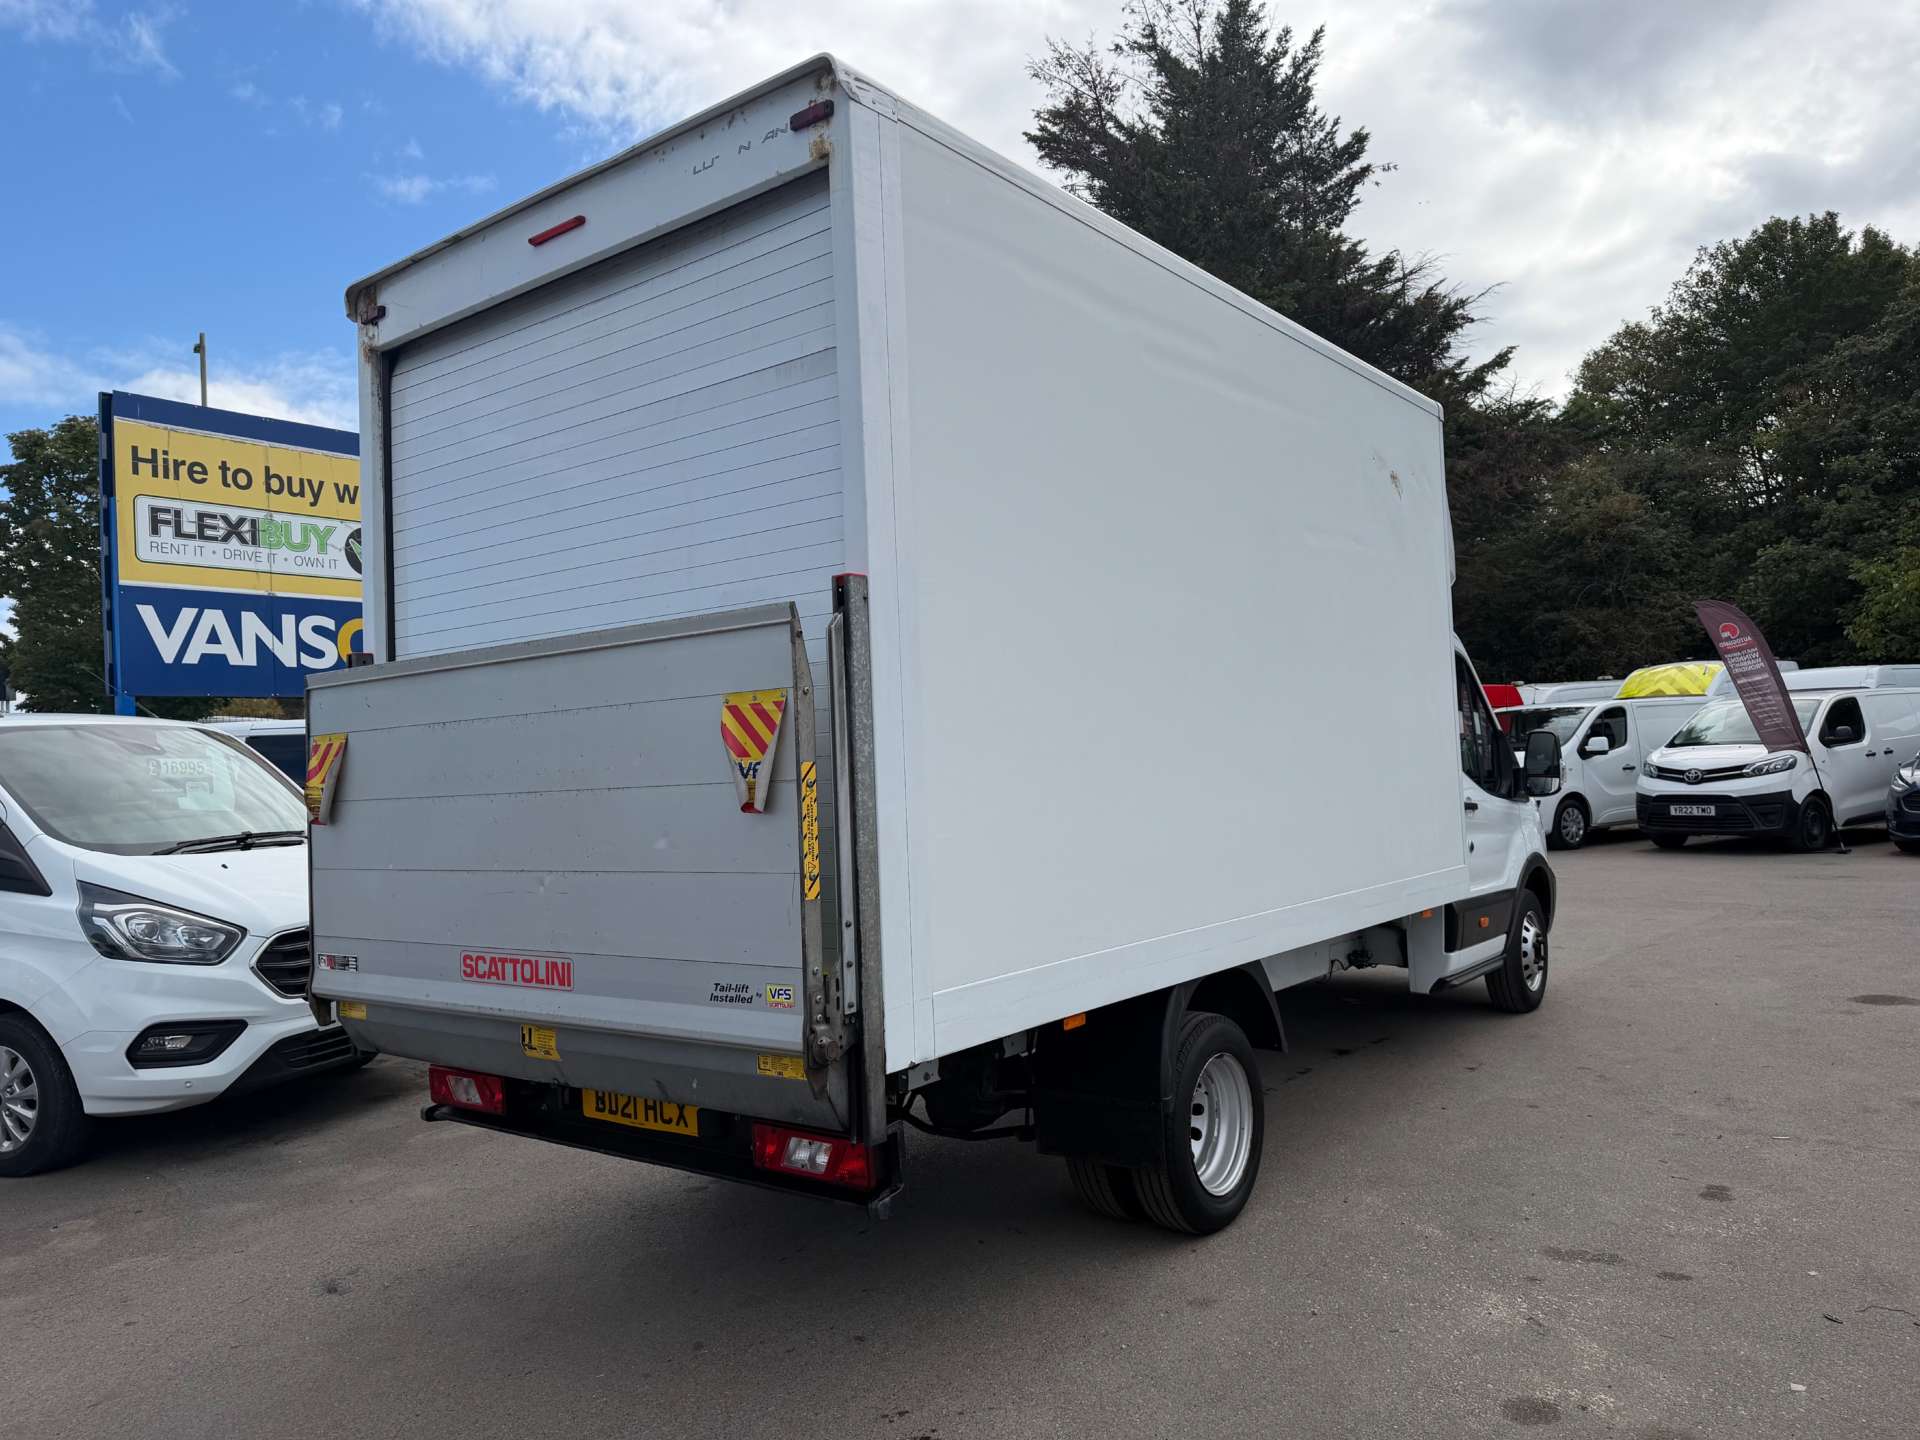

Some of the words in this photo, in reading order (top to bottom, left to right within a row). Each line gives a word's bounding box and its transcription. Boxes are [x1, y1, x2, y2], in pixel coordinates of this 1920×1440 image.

[131, 445, 208, 484] Hire
[218, 460, 253, 490] to
[264, 466, 325, 507] buy
[148, 504, 337, 555] FLEXIBUY
[150, 541, 192, 557] RENT
[194, 545, 205, 557] IT
[223, 548, 262, 563] DRIVE
[267, 553, 279, 565] IT
[294, 555, 325, 569] OWN
[328, 558, 340, 570] IT
[462, 954, 572, 988] SCATTOLINI
[709, 992, 754, 1004] Installed
[713, 982, 750, 994] Tail-lift
[768, 987, 792, 1001] VFS
[595, 1089, 638, 1120] BD21
[643, 1097, 689, 1129] HCX
